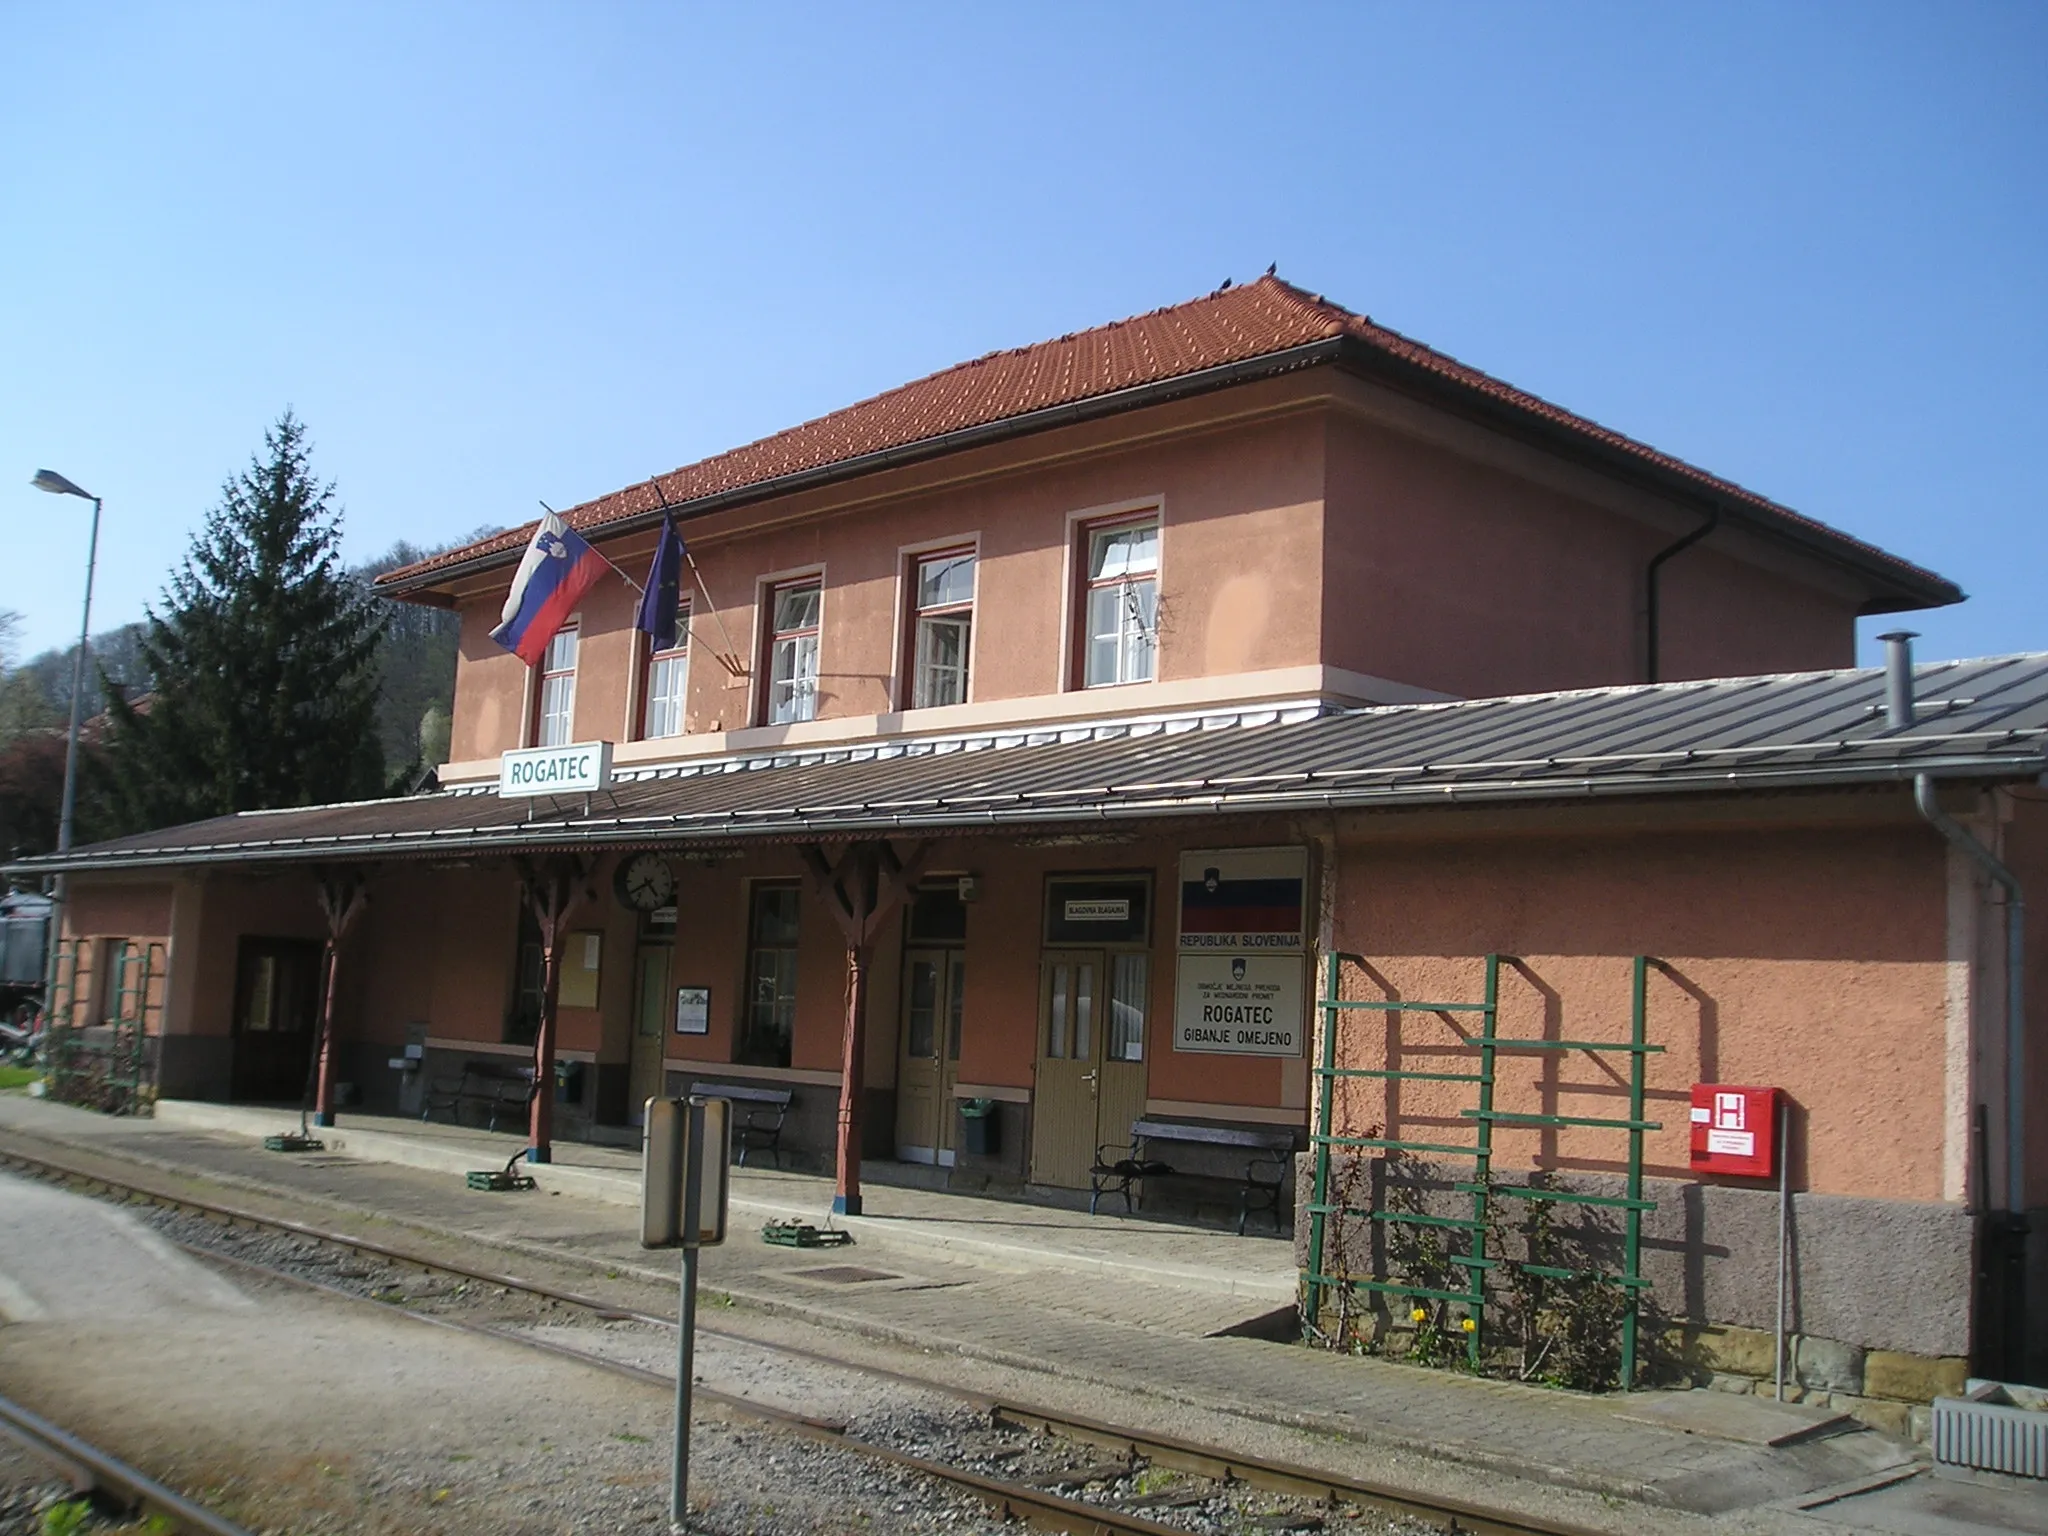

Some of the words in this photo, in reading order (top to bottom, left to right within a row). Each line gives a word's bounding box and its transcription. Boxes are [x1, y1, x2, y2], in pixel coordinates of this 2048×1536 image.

[511, 755, 589, 785] ROGATEC
[1180, 935, 1237, 947] REPUBLIKA
[1242, 935, 1300, 947] SLOVENIJA
[1203, 1005, 1273, 1024] ROGATEC
[1184, 1028, 1231, 1043] GIBANJE
[1237, 1030, 1292, 1046] OMEJENO
[1719, 1096, 1741, 1127] H
